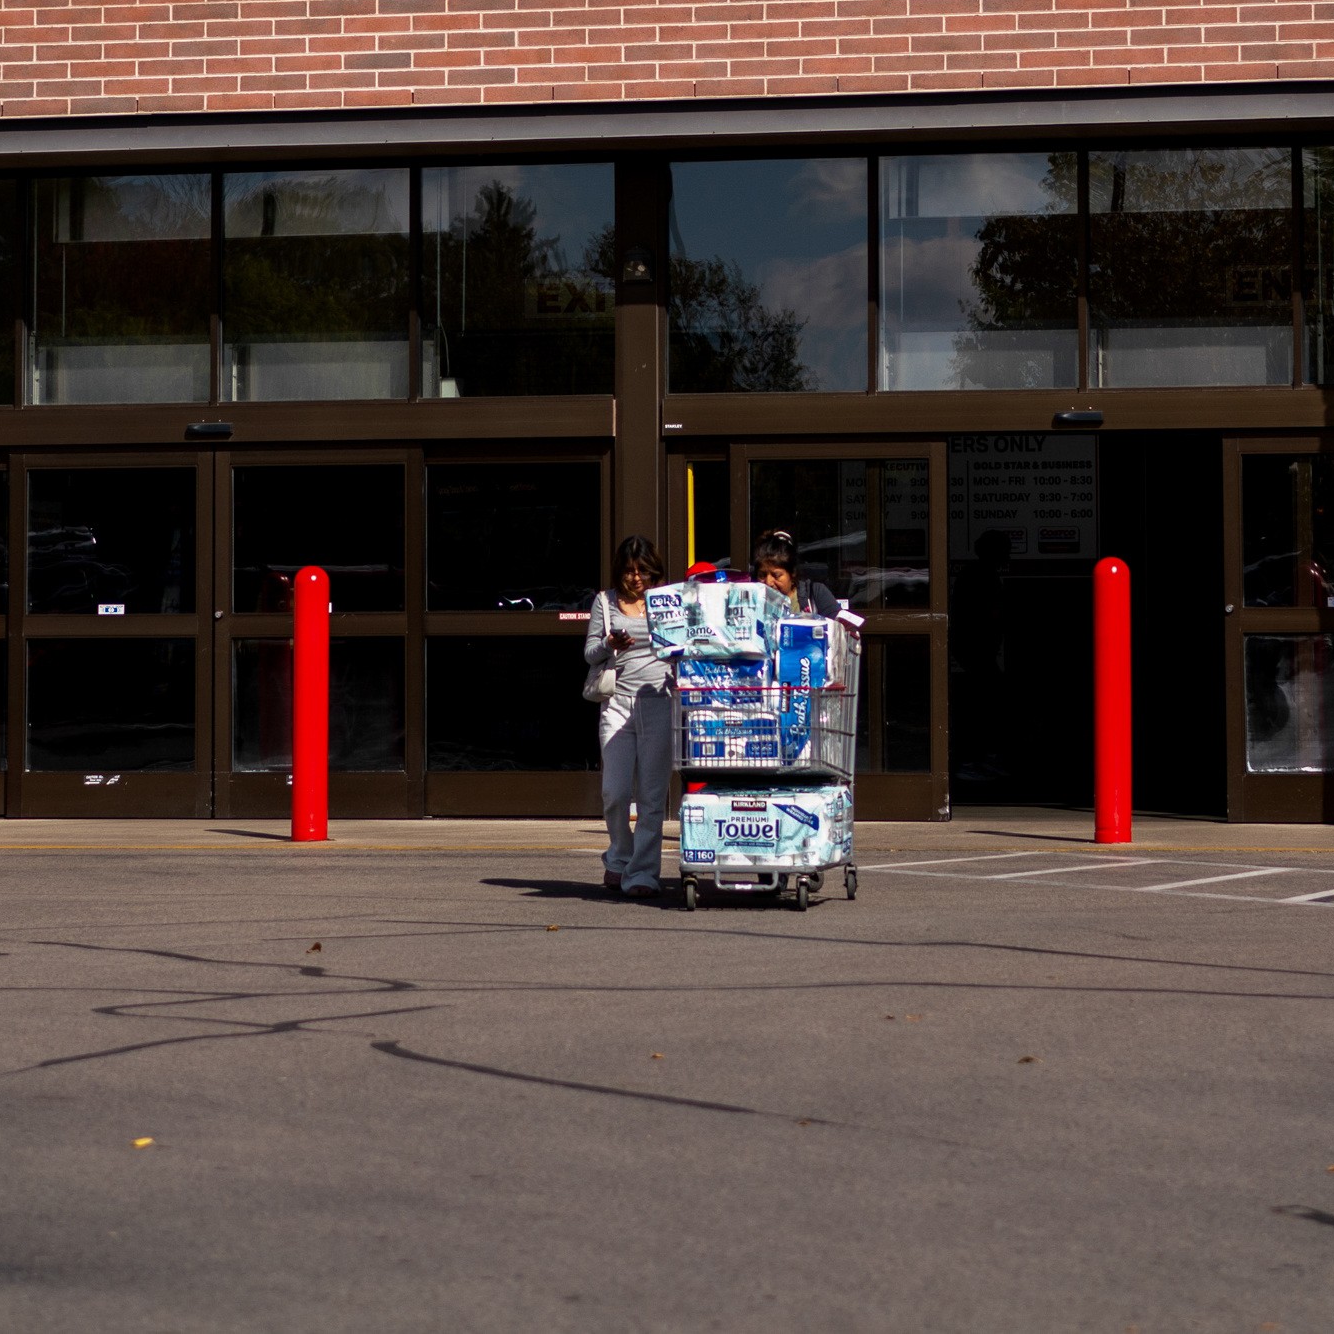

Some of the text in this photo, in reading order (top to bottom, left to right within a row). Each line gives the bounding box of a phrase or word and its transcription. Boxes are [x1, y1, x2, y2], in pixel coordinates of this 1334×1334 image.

[537, 282, 611, 313] EXI
[993, 435, 1046, 453] ONLY
[973, 460, 1092, 470] GOLD STAR & BUSINESS
[973, 476, 999, 486] MON
[1008, 476, 1025, 486] FRI
[1033, 476, 1061, 485] 10:00
[1070, 476, 1092, 485] 8:30
[973, 493, 1031, 503] SATURDAY
[1039, 492, 1061, 502] 9:30
[1071, 492, 1093, 502] 7:00
[973, 509, 1018, 519] SUNDAY
[1033, 509, 1061, 518] 10:00
[1071, 509, 1093, 518] 6:00
[559, 612, 577, 620] CAUTION
[789, 700, 807, 736] Bath
[714, 819, 780, 839] Towel
[697, 850, 714, 859] 160
